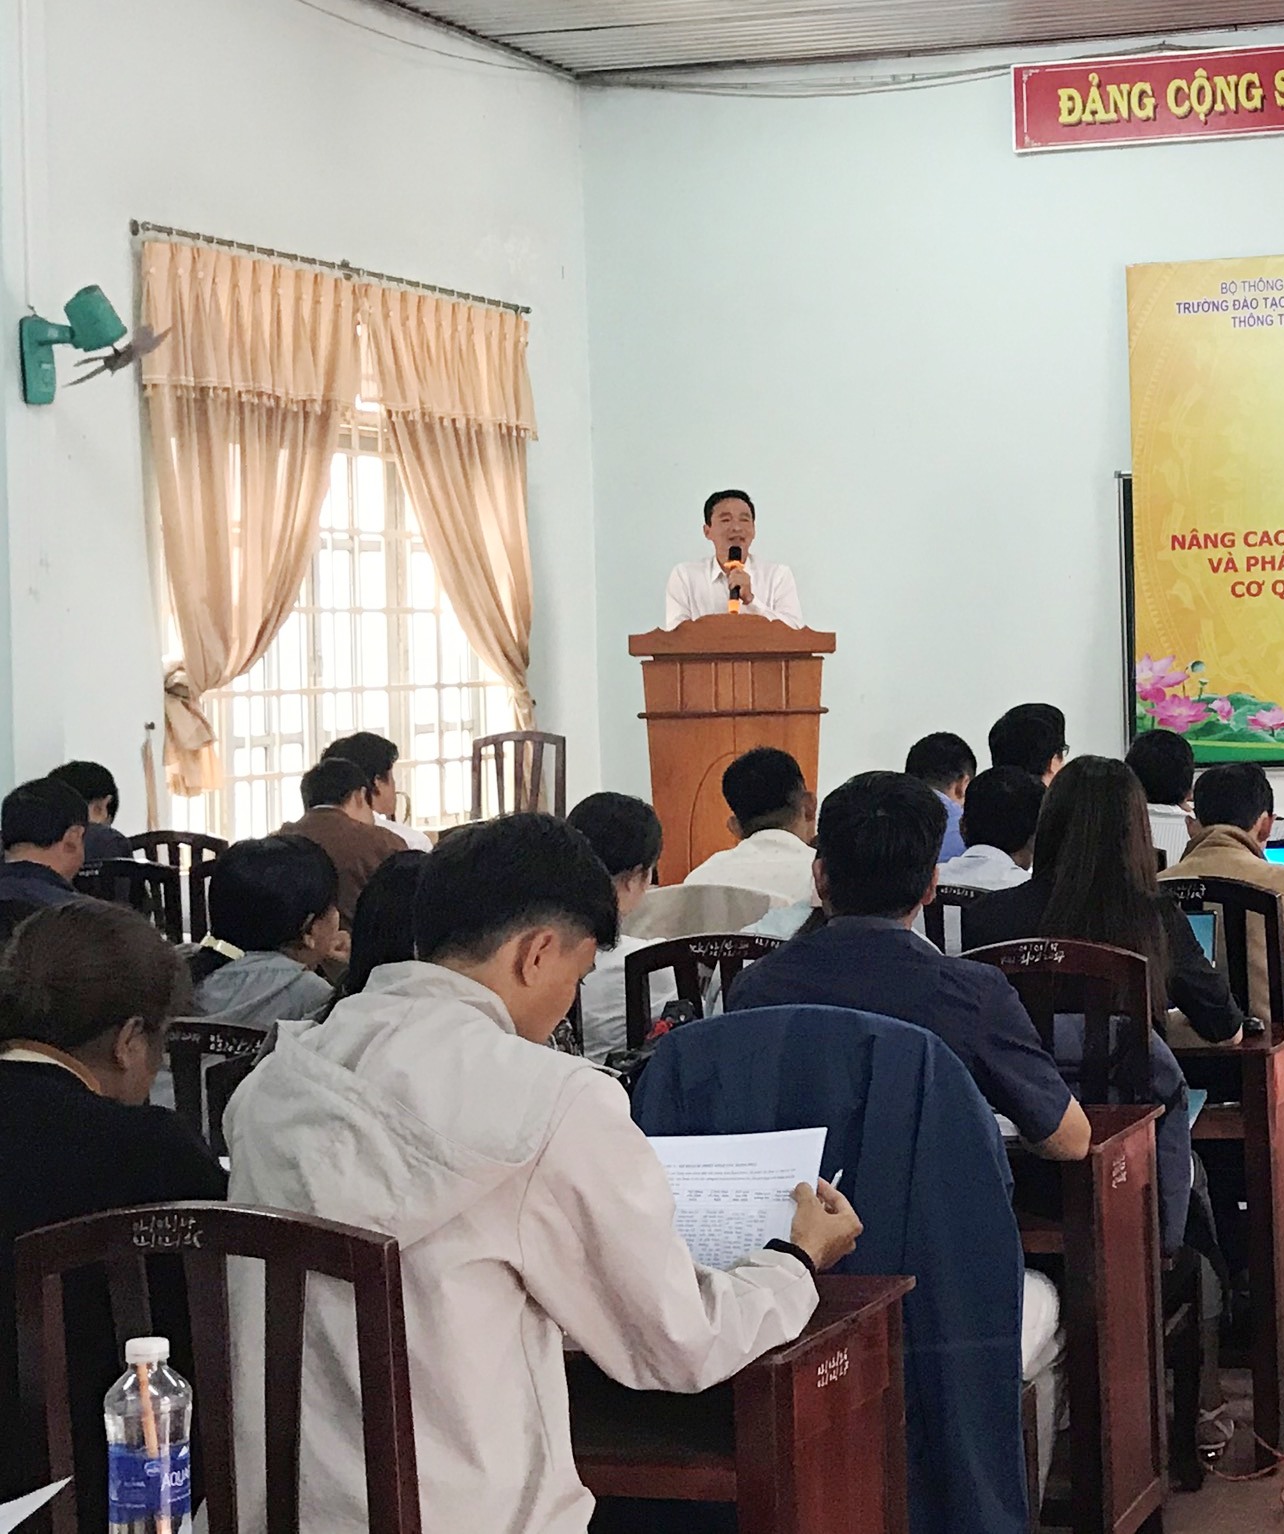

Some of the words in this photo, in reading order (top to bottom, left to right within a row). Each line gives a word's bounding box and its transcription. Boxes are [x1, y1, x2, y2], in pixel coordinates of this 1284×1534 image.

[1058, 73, 1155, 125] ĐẢNG
[1166, 68, 1263, 123] CỘNG
[1220, 280, 1238, 295] BỘ
[1241, 277, 1284, 292] THÔNG
[1231, 312, 1274, 328] THÔNG
[1171, 529, 1236, 551] NÂNG
[1208, 551, 1239, 574] VÀ
[1230, 580, 1265, 599] CƠ
